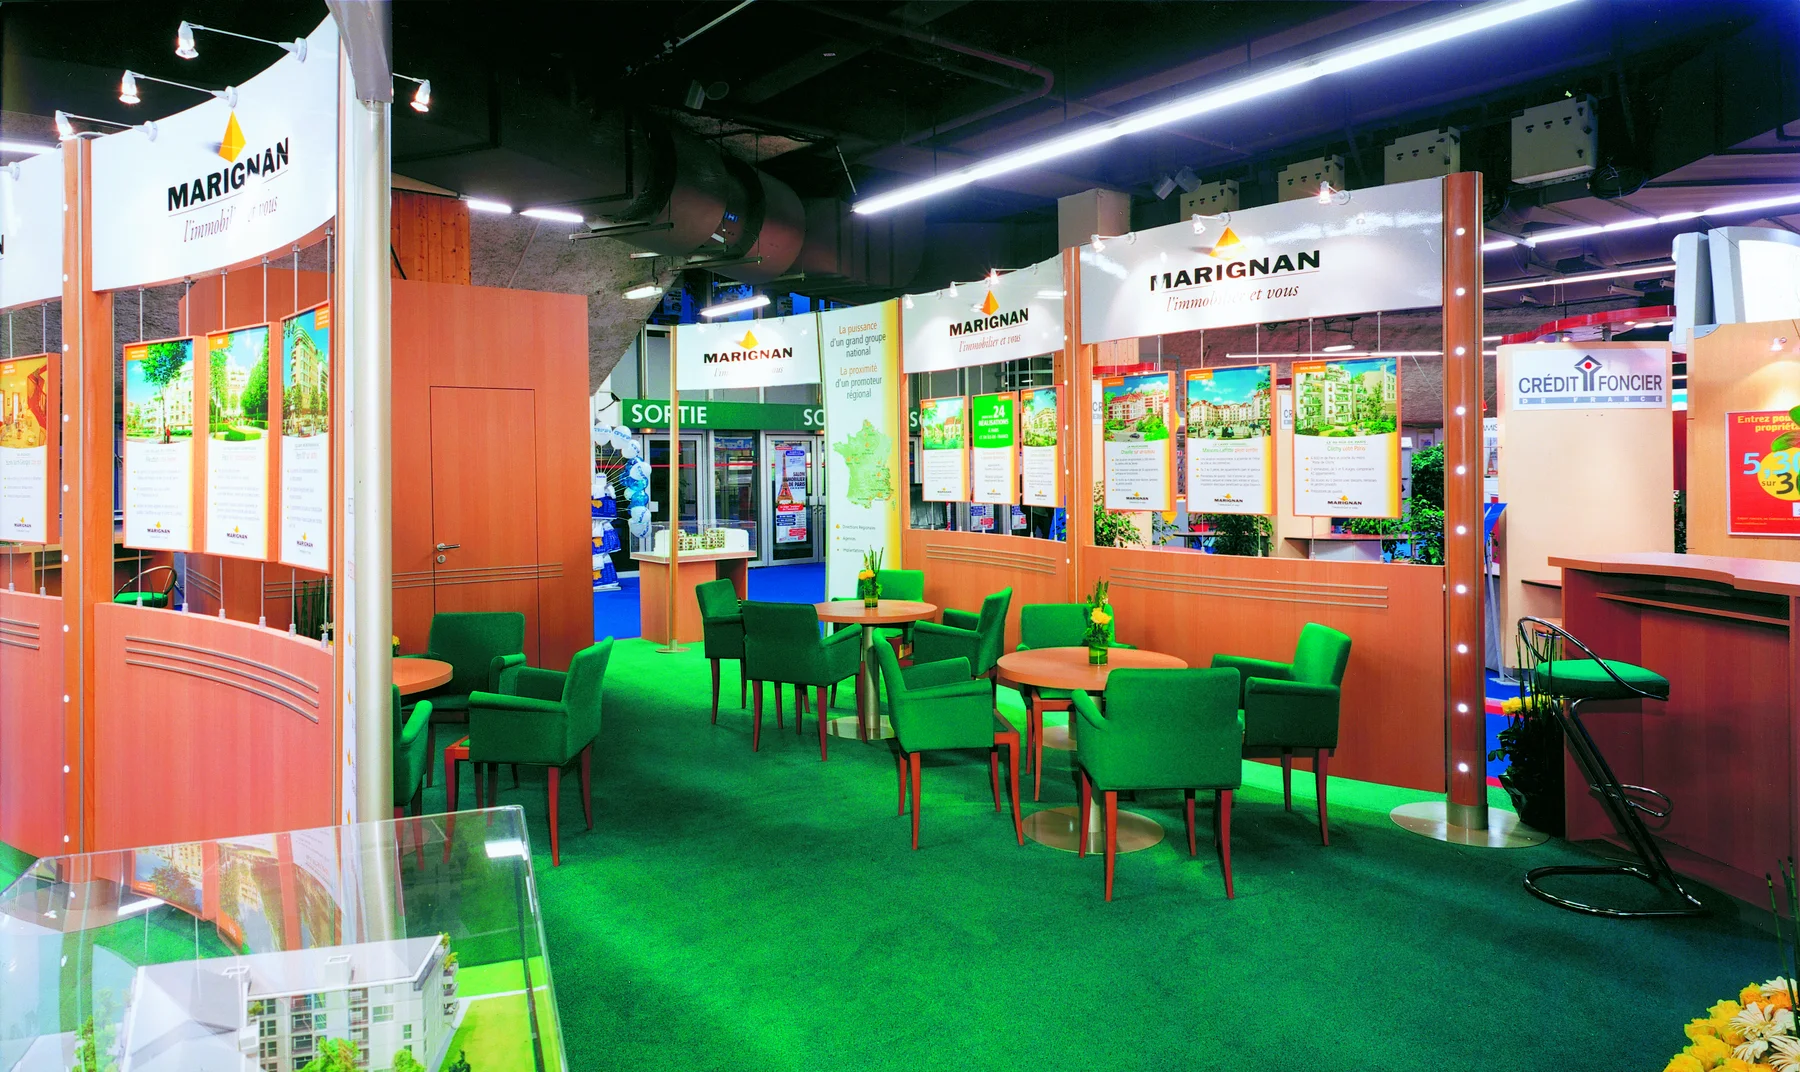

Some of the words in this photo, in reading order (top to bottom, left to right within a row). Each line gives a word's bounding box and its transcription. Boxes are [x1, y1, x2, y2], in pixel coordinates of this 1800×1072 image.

[168, 137, 288, 211] MARIGNAN
[1150, 250, 1320, 292] MARIGNAN
[1250, 289, 1262, 302] et
[1267, 285, 1300, 300] vous
[839, 326, 846, 334] La
[848, 322, 878, 335] puissance
[950, 308, 1028, 336] MARIGNAN
[830, 338, 844, 348] d'un
[846, 334, 863, 348] grand
[864, 334, 886, 345] groupe
[704, 346, 793, 364] MARIGNAN
[846, 346, 871, 358] national
[840, 367, 847, 375] La
[849, 364, 878, 376] proximité
[835, 378, 849, 388] d'un
[851, 377, 882, 388] promoteur
[1518, 374, 1579, 393] CRÉDIT
[1599, 374, 1662, 391] FONCIER
[846, 388, 871, 401] régional
[993, 405, 1005, 418] 24
[1772, 415, 1791, 424] pou
[1755, 422, 1800, 433] propriét
